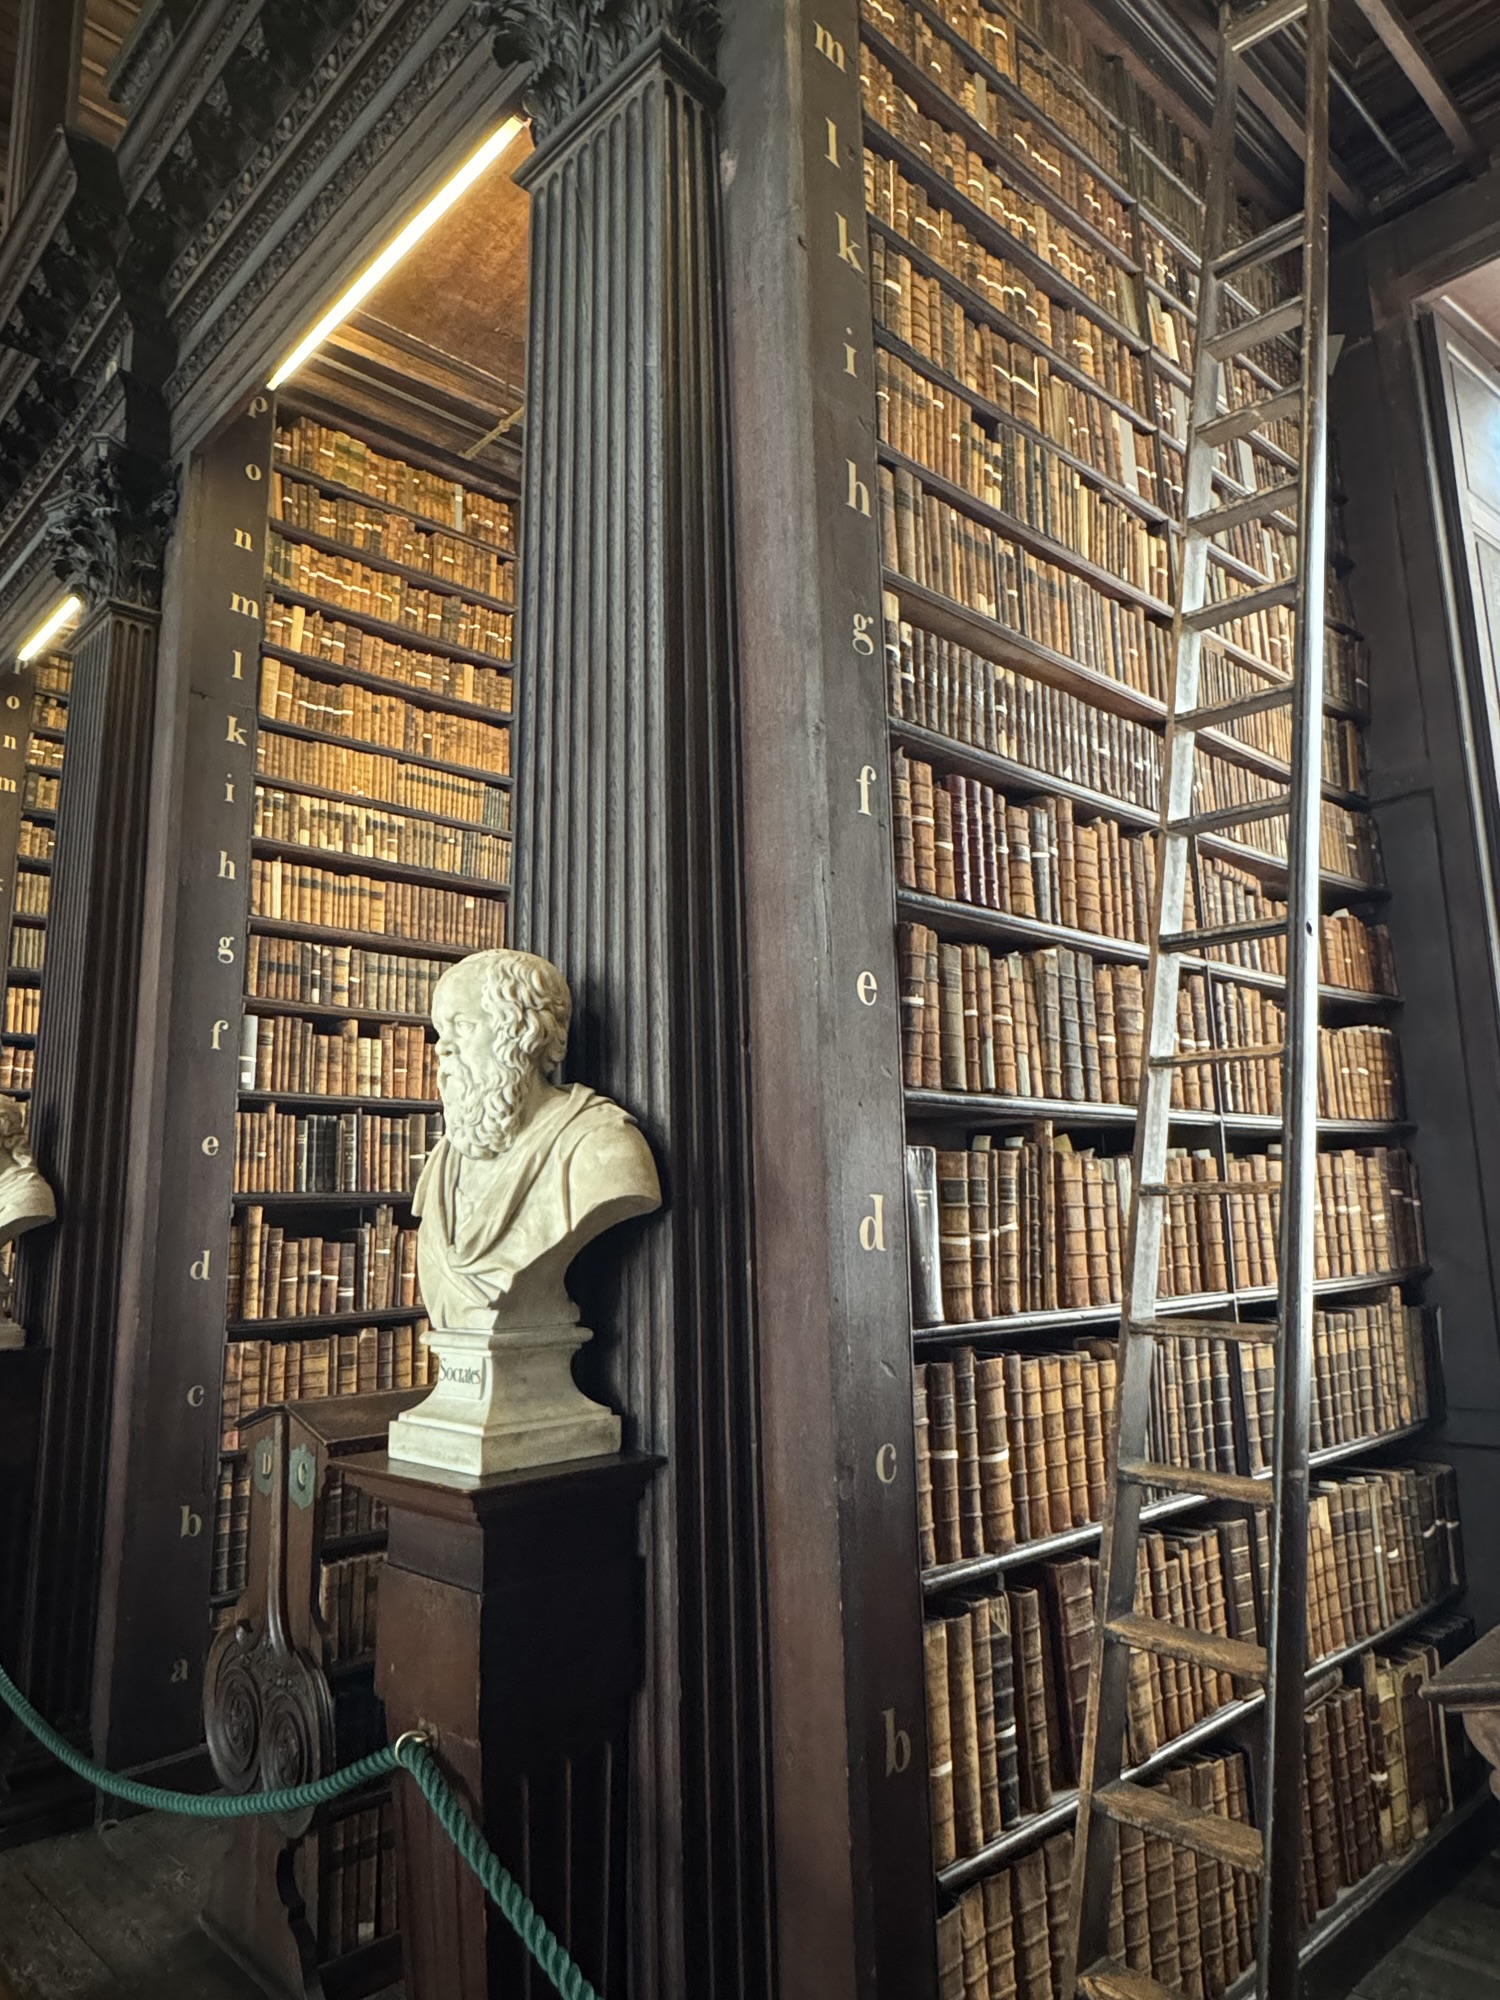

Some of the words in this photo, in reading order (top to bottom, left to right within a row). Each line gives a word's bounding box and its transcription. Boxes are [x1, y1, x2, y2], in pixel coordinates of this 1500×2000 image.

[813, 20, 846, 73] m
[835, 211, 864, 274] k
[843, 326, 858, 378] i
[247, 396, 268, 418] p
[245, 464, 262, 481] o
[845, 458, 872, 518] h
[234, 527, 254, 552] n
[229, 592, 259, 620] m
[852, 613, 874, 656] g
[6, 695, 20, 710] o
[3, 734, 17, 750] n
[225, 715, 247, 747] k
[224, 773, 235, 803] i
[856, 765, 876, 816] f
[217, 851, 237, 880] h
[217, 936, 234, 964] g
[856, 971, 878, 1006] e
[210, 1020, 228, 1050] f
[201, 1135, 219, 1156] e
[859, 1194, 887, 1251] d
[190, 1249, 211, 1281] d
[187, 1385, 205, 1407] c
[876, 1443, 897, 1484] c
[179, 1505, 202, 1538] b
[170, 1658, 189, 1683] a
[882, 1707, 912, 1778] b
